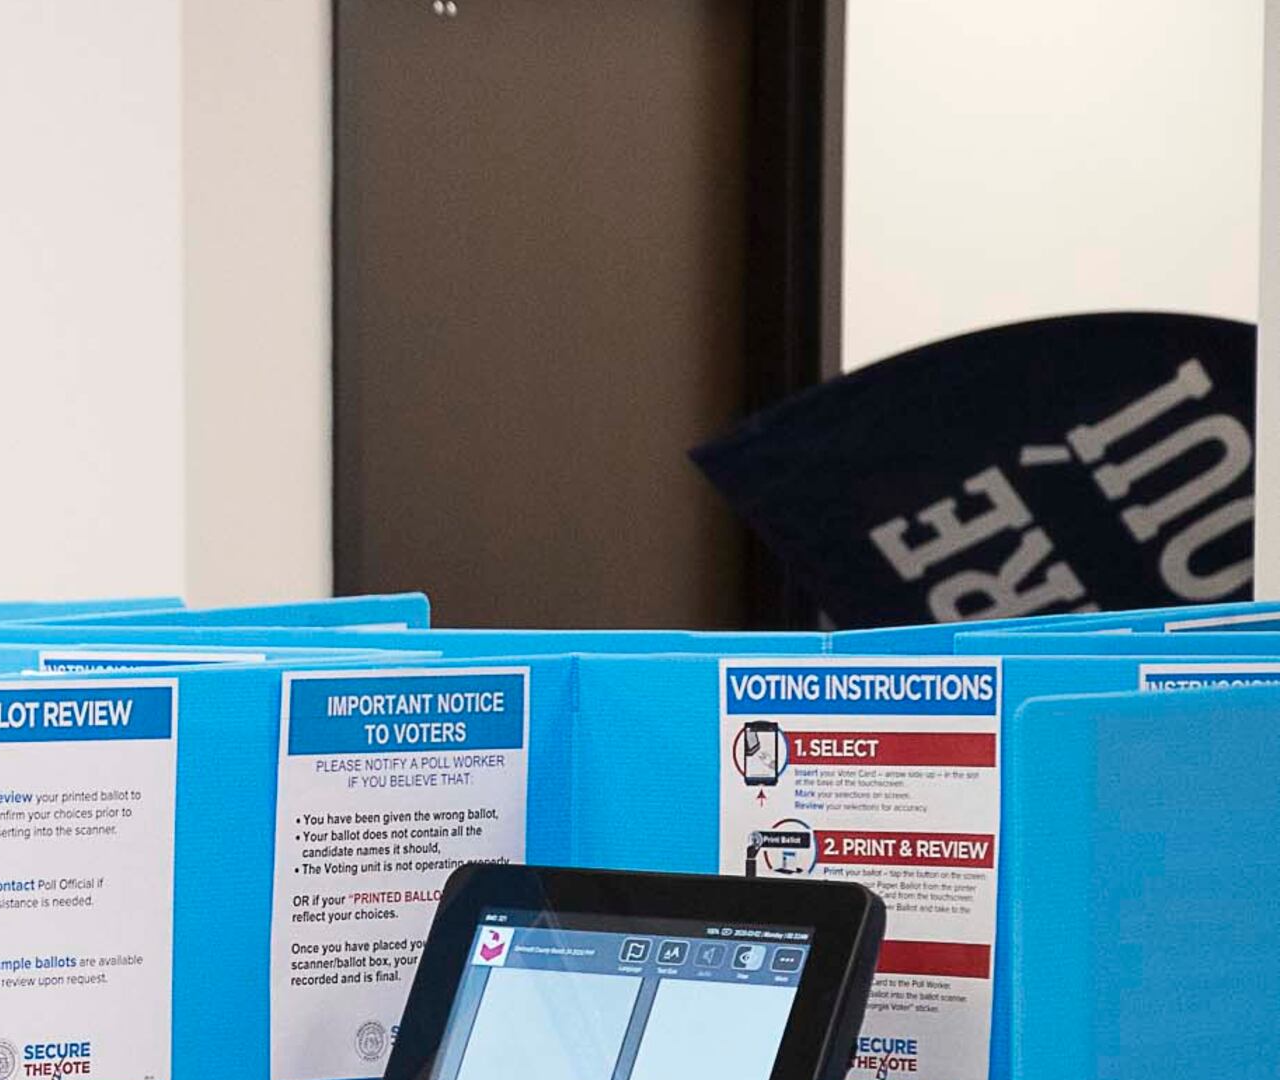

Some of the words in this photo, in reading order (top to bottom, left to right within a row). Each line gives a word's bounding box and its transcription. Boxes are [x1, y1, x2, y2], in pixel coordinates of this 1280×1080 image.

[731, 675, 820, 700] VOTING
[825, 674, 994, 701] INSTRUCTIONS
[327, 694, 433, 717] IMPORTANT
[437, 691, 504, 713] NOTICE
[44, 700, 133, 727] REVIEW
[365, 724, 389, 745] TO
[394, 721, 466, 744] VOTERS
[794, 739, 807, 757] 1.
[810, 739, 879, 757] SELECT
[316, 759, 361, 772] PLEASE
[364, 758, 407, 770] NOTIFY
[409, 757, 418, 769] A
[420, 756, 450, 768] POLL
[452, 754, 504, 767] WORKER
[348, 776, 358, 787] IF
[361, 775, 386, 787] YOU
[389, 773, 437, 787] BELIEVE
[440, 772, 474, 784] THAT:
[35, 794, 58, 804] your
[61, 791, 98, 802] printed
[100, 790, 128, 800] ballot
[130, 790, 141, 800] to
[27, 811, 50, 822] your
[53, 809, 93, 819] choices
[95, 807, 119, 819] prior
[121, 807, 132, 817] to
[302, 814, 324, 825] You
[326, 813, 352, 824] have
[354, 813, 380, 823] been
[382, 811, 411, 825] given
[414, 810, 430, 821] the
[432, 811, 464, 822] wrong
[467, 808, 498, 819] ballot,
[33, 826, 53, 836] into
[54, 825, 72, 836] the
[302, 831, 328, 841] Your
[330, 829, 360, 840] ballot
[362, 829, 388, 839] does
[390, 828, 408, 838] not
[410, 826, 449, 838] contain
[450, 825, 463, 836] all
[465, 825, 482, 836] the
[302, 846, 353, 857] candidate
[356, 846, 390, 855] names
[392, 844, 400, 854] it
[402, 842, 440, 854] should,
[823, 839, 839, 855] 2.
[843, 839, 895, 857] PRINT
[900, 840, 913, 857] &
[916, 840, 988, 860] REVIEW
[302, 863, 321, 874] The
[324, 863, 358, 875] Voting
[360, 862, 380, 872] unit
[383, 861, 392, 871] is
[395, 860, 412, 870] not
[415, 858, 464, 873] operating
[37, 879, 56, 890] Poll
[59, 878, 94, 889] Official
[97, 877, 103, 887] if
[40, 898, 50, 907] is
[292, 895, 309, 906] OR
[312, 894, 319, 905] if
[321, 896, 346, 908] your
[292, 911, 325, 922] reflect
[328, 911, 352, 923] your
[354, 909, 398, 919] choices.
[291, 943, 319, 954] Once
[321, 944, 342, 955] you
[344, 941, 370, 951] have
[372, 939, 407, 952] placed
[34, 956, 76, 968] ballots
[79, 958, 96, 966] are
[98, 955, 143, 965] available
[291, 957, 366, 969] scanner/ballot
[368, 956, 391, 966] box,
[393, 955, 418, 970] your
[1, 978, 36, 987] review
[38, 976, 64, 986] upon
[290, 973, 338, 985] recorded
[340, 972, 361, 983] and
[363, 971, 373, 982] is
[375, 970, 401, 981] final.
[23, 1042, 91, 1060] SECURE
